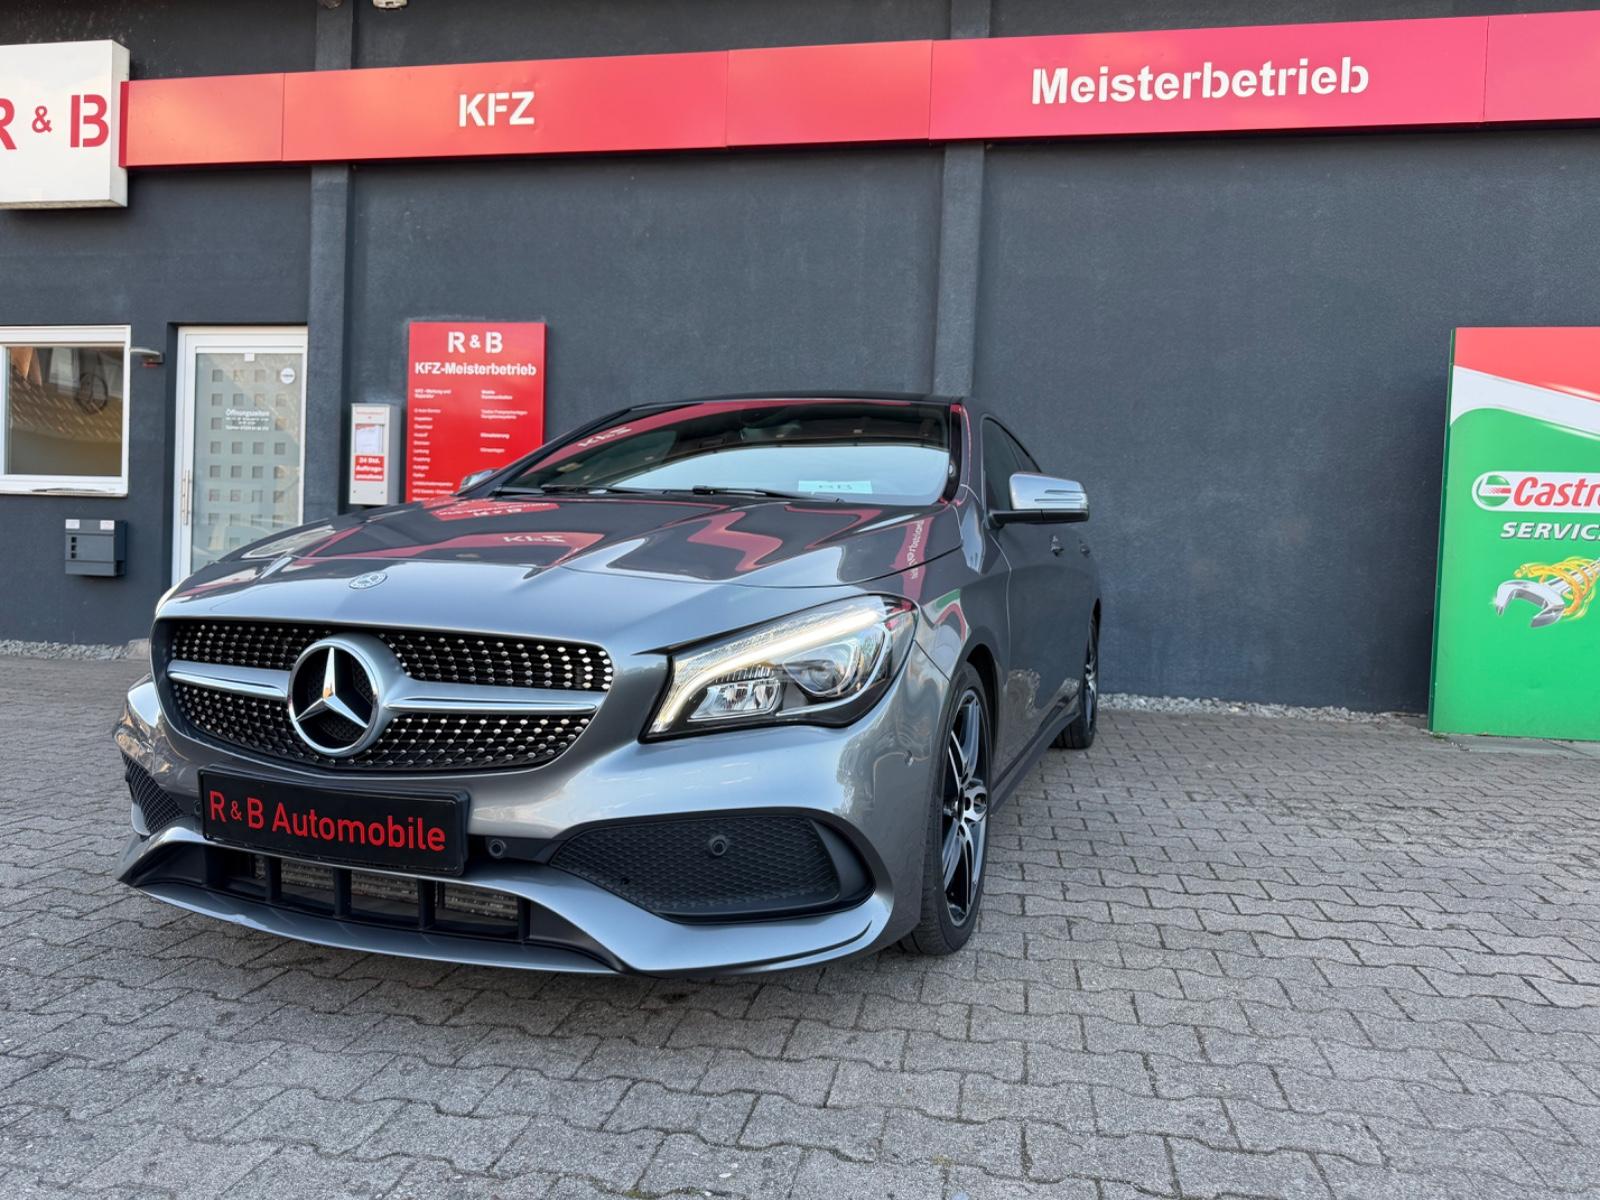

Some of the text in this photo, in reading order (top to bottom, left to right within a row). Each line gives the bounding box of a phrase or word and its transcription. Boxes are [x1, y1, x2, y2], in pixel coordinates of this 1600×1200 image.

[1031, 56, 1369, 104] Meisterbetrieb
[32, 105, 52, 133] &
[70, 94, 109, 148] B
[458, 91, 535, 128] KFZ
[448, 331, 503, 353] R & B
[415, 362, 537, 376] KFZ-Meisterbetrieb
[1513, 476, 1600, 507] Castr
[1500, 521, 1600, 541] SERVIC
[209, 790, 447, 852] R & B Automobile
